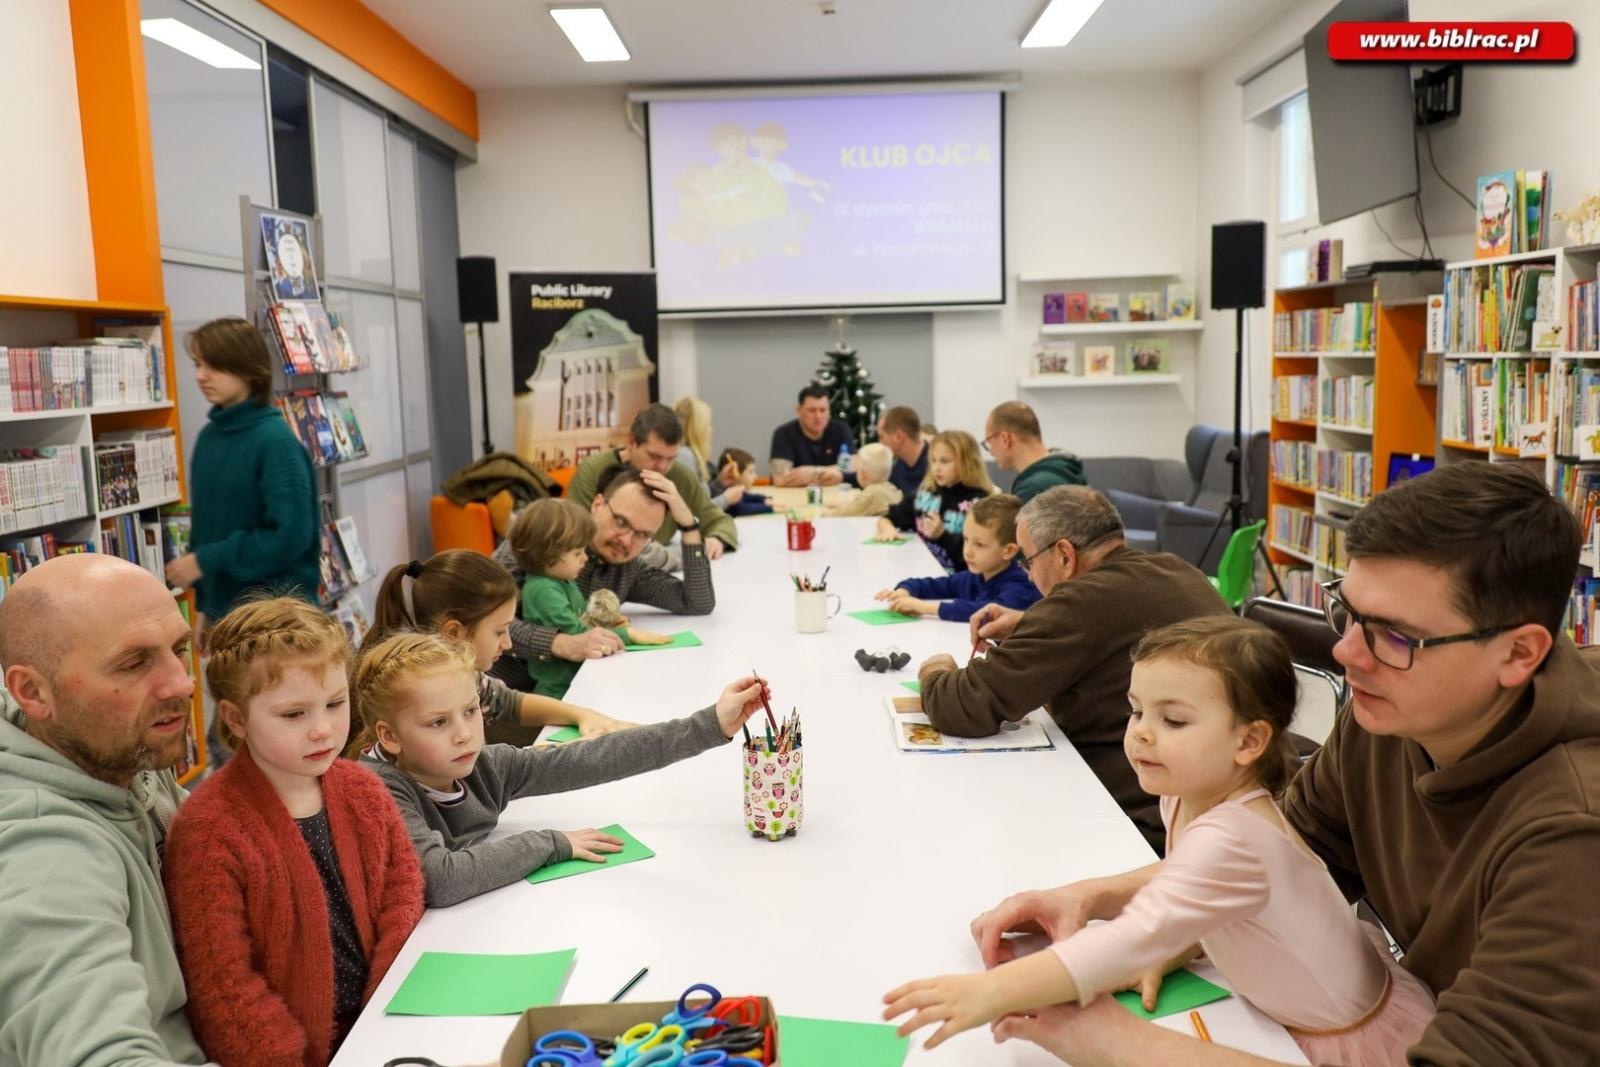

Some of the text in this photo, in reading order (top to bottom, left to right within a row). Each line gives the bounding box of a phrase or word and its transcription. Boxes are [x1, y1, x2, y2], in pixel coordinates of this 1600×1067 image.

[841, 144, 992, 168] KLUB OJCA
[531, 284, 612, 299] Public Library
